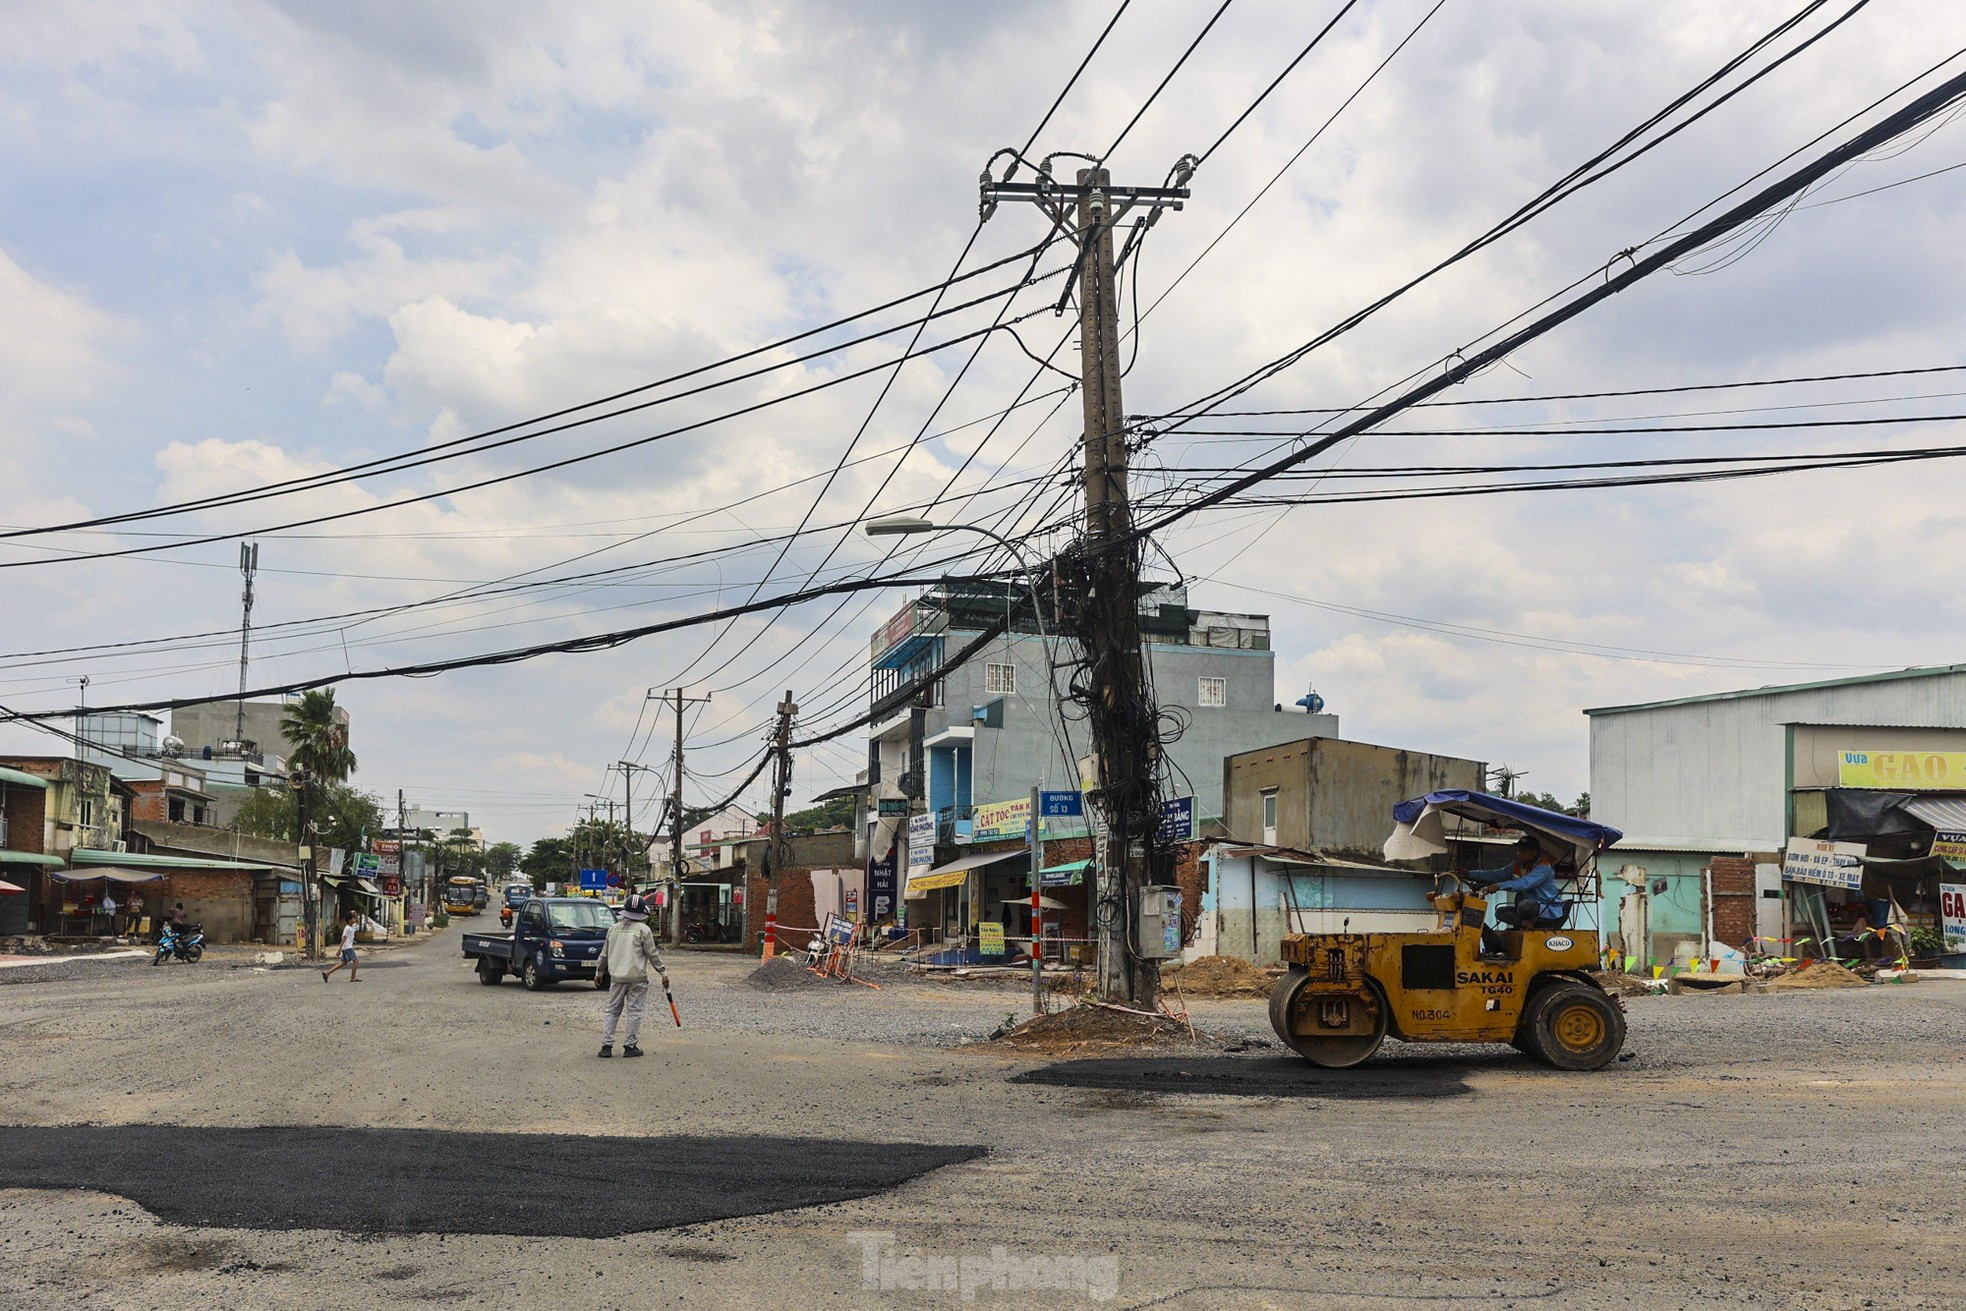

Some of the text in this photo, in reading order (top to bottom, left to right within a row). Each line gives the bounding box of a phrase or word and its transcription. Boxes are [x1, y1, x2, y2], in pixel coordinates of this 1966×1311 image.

[1845, 752, 1868, 766] Vựa
[1049, 794, 1074, 802] ĐƯỜNG
[1049, 803, 1068, 814] SỐ 13
[995, 807, 1010, 823] TÓC
[874, 867, 892, 879] NHẬT
[876, 878, 889, 889] HẢI
[1944, 925, 1966, 935] LONG
[1456, 972, 1513, 984] SAKAI
[1480, 986, 1513, 995] TG40
